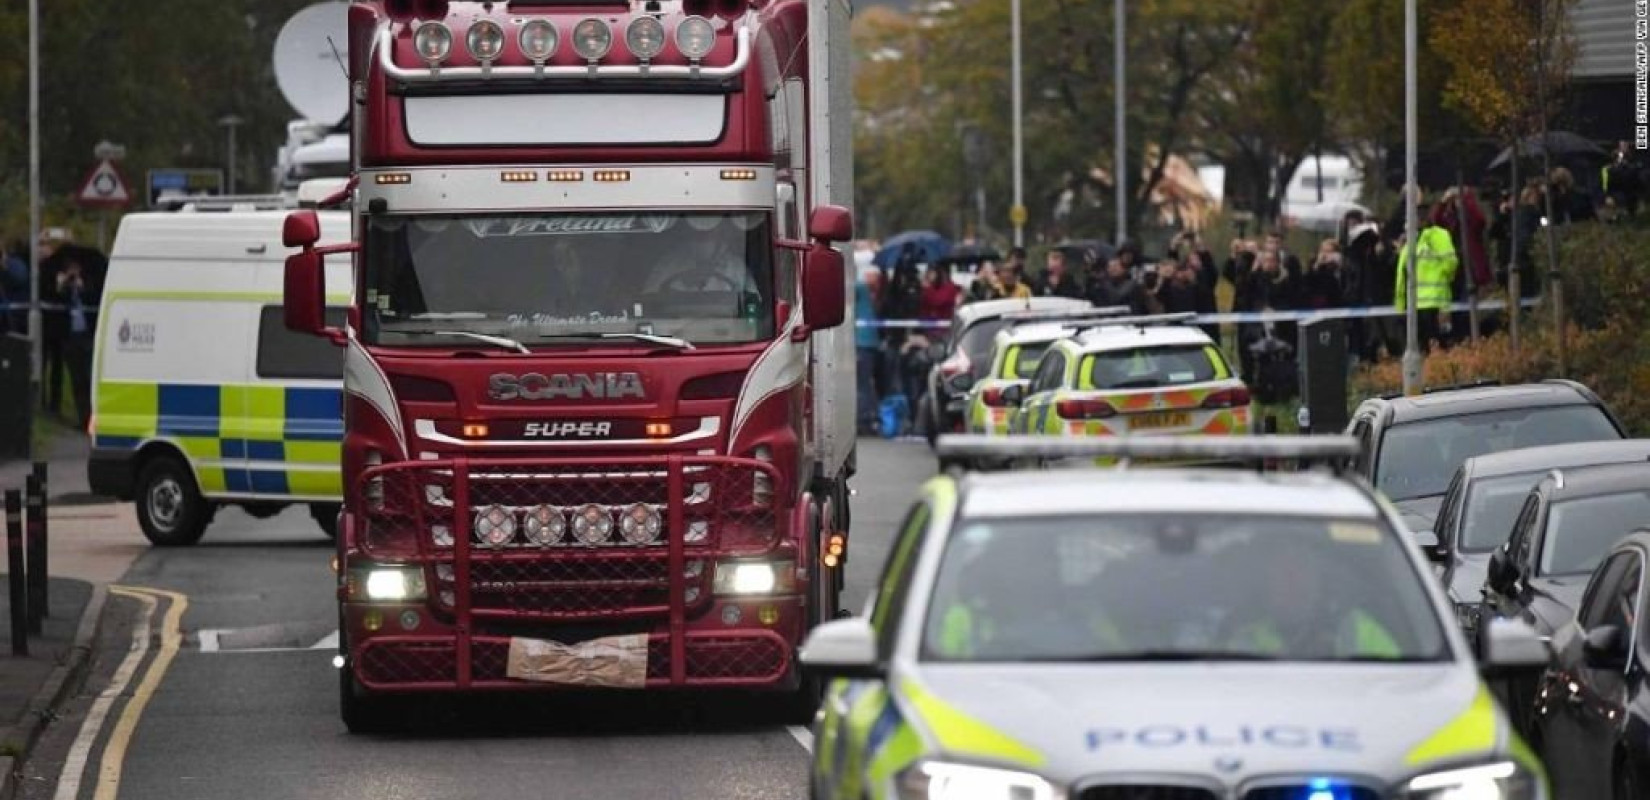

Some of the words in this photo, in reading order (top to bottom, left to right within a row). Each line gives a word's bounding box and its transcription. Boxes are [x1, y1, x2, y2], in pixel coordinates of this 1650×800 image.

[507, 313, 529, 329] The
[488, 372, 645, 400] SCANIA
[524, 422, 611, 436] SUPER
[1085, 725, 1363, 751] POLICE
